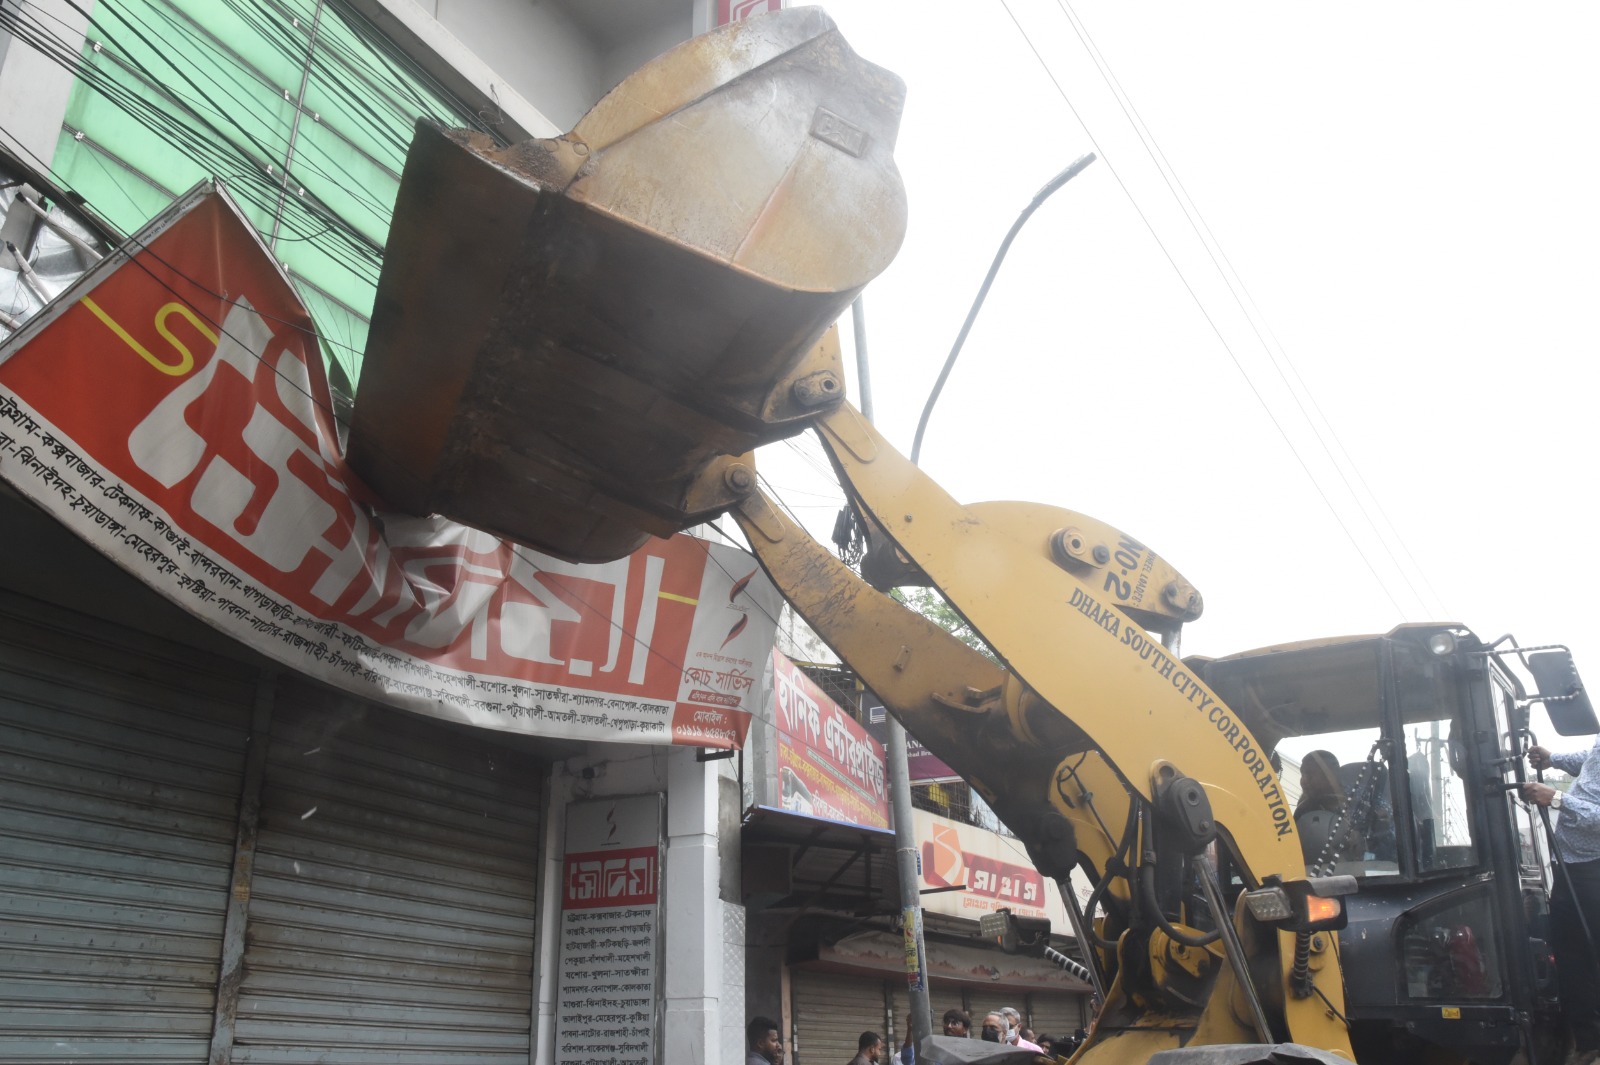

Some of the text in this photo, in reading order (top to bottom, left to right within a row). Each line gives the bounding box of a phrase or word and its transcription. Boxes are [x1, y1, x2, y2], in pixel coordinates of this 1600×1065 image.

[684, 666, 756, 695] কোচ সার্ভিস
[693, 709, 723, 726] মোবাইল
[1068, 587, 1292, 842] DHAKA SOUTH CITY CORPORATION.
[776, 666, 820, 748] হানিফ
[824, 704, 885, 801] এন্টারপ্রাইজ
